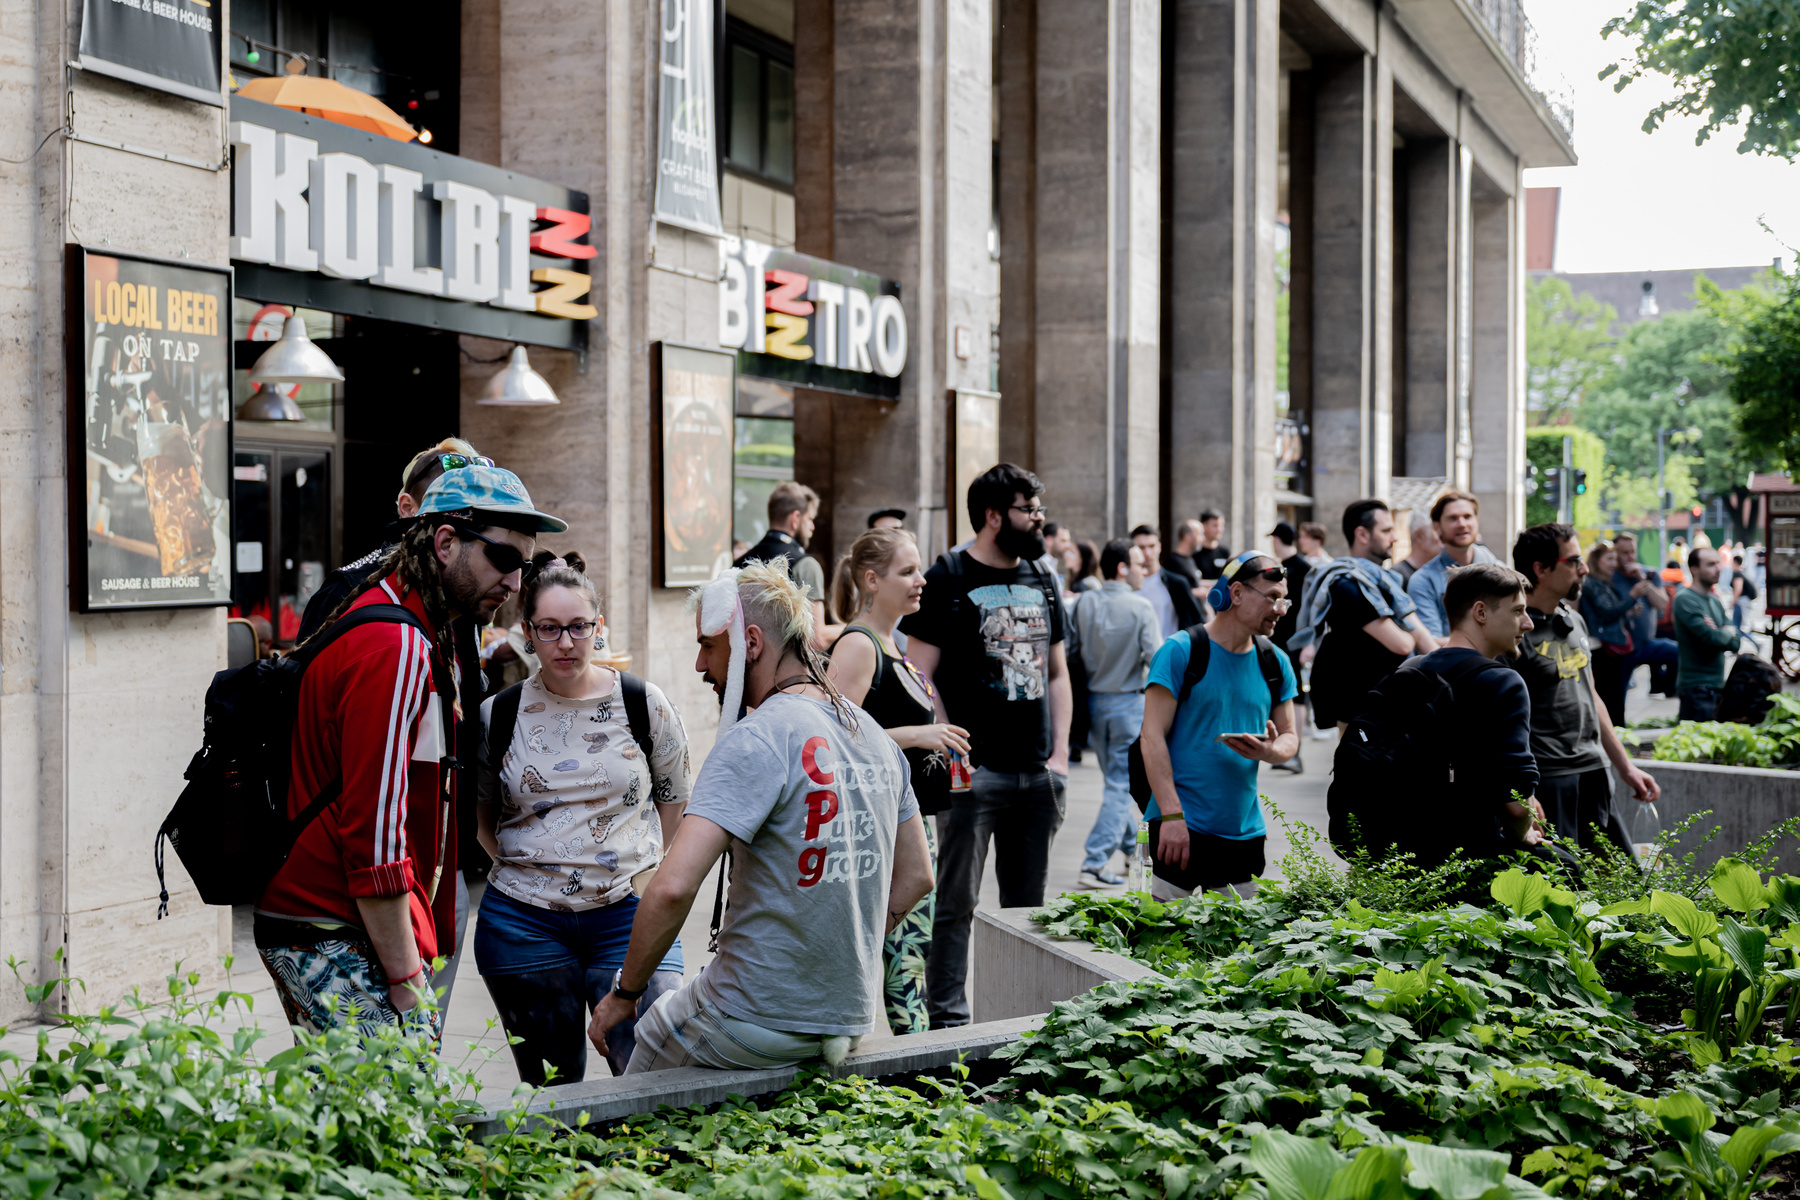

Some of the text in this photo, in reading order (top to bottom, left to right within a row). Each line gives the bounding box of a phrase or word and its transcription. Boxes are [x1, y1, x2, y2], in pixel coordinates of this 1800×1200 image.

[152, 0, 178, 21] BEER
[179, 9, 213, 32] HOUSE
[661, 158, 693, 182] CRAFT
[94, 279, 218, 336] LOCAL BEER
[123, 334, 200, 362] ON TAP
[101, 578, 142, 590] SAUSAGE
[143, 578, 150, 589] &
[151, 577, 171, 589] BEER
[172, 576, 200, 588] HOUSE
